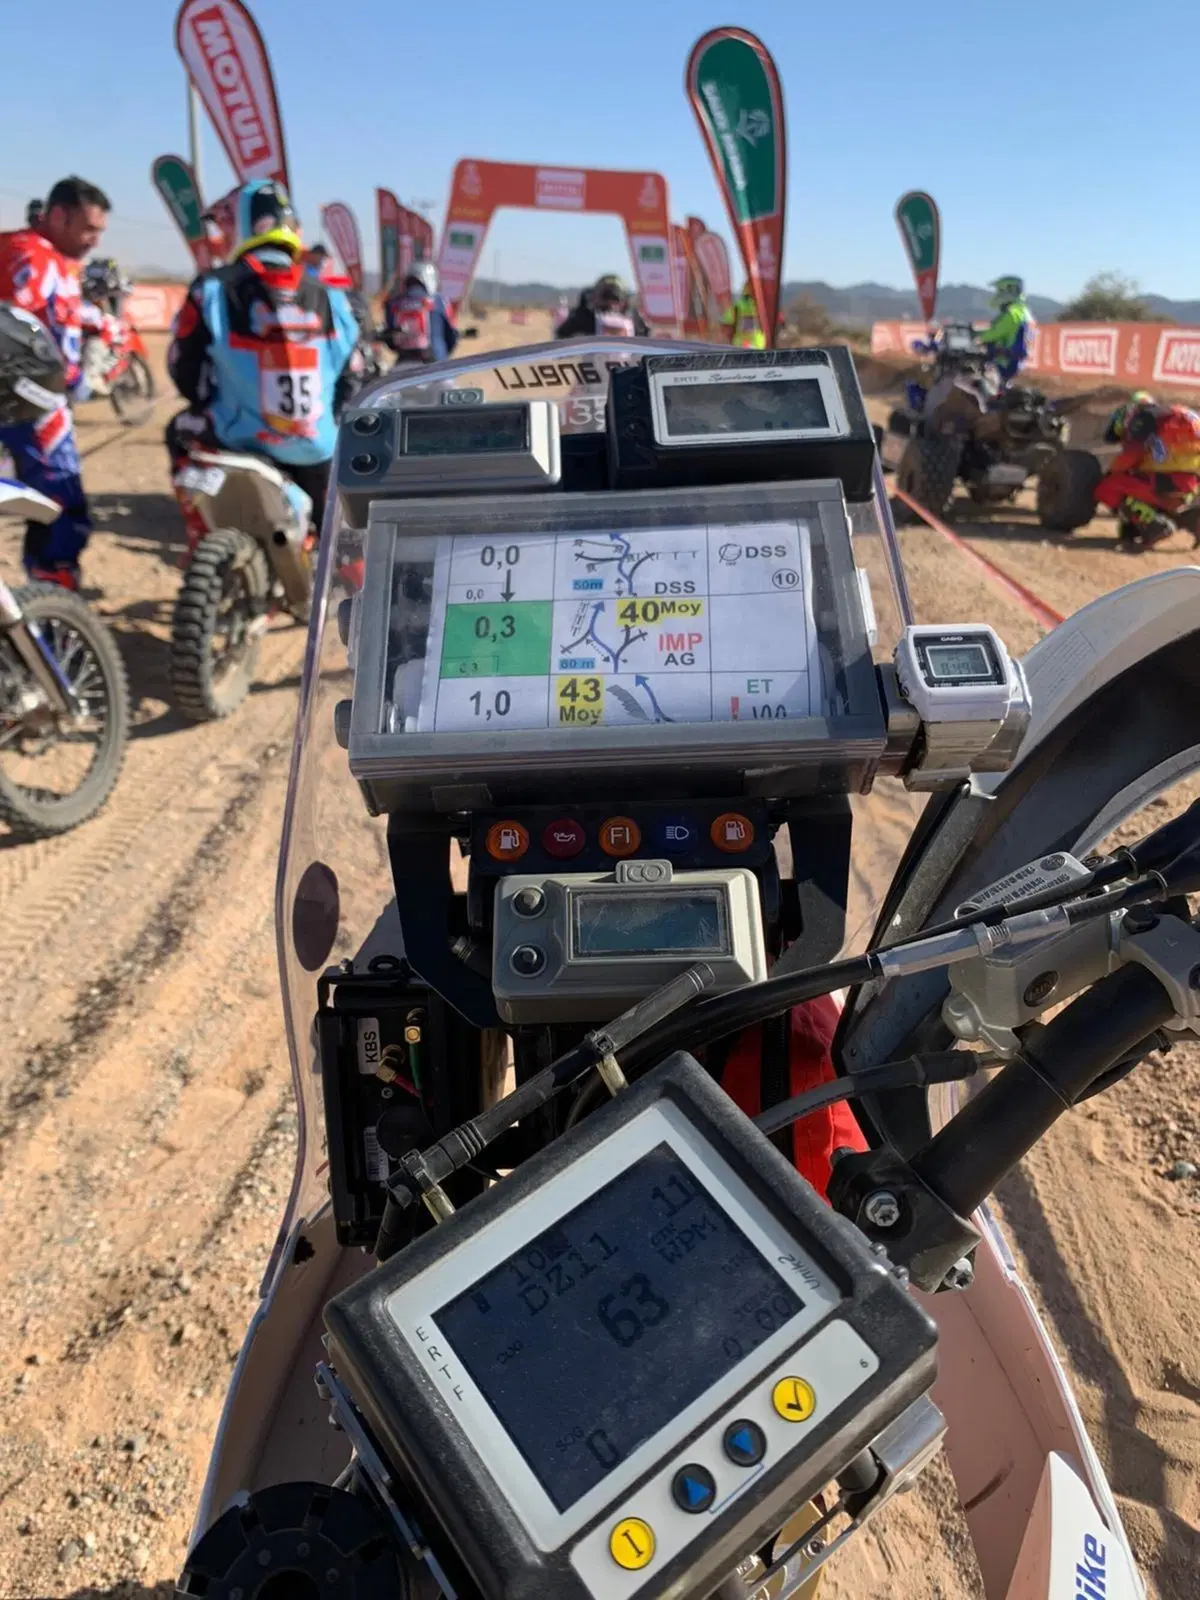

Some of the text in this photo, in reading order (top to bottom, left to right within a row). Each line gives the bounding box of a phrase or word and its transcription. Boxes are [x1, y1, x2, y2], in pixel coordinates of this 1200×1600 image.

[197, 20, 265, 158] MOTUL
[277, 374, 313, 416] 35
[481, 545, 520, 571] 0,0
[745, 545, 788, 558] DSS
[654, 581, 697, 594] DSS
[775, 572, 797, 586] 10
[465, 589, 485, 601] 0,0
[619, 600, 702, 623] 40 Moy
[475, 615, 516, 643] 0,3
[658, 632, 704, 652] IMP
[664, 652, 696, 667] AG
[559, 677, 602, 703] 43
[747, 678, 774, 694] ET
[469, 690, 511, 721] 1,0
[560, 705, 602, 725] Moy
[611, 827, 630, 845] FI
[620, 862, 667, 884] ICO
[363, 1030, 378, 1064] KBS
[658, 1215, 718, 1265] WPM
[518, 1232, 620, 1317] DZ11
[597, 1272, 669, 1348] 63
[415, 1326, 464, 1402] ERTF
[1076, 1533, 1106, 1600] ike
